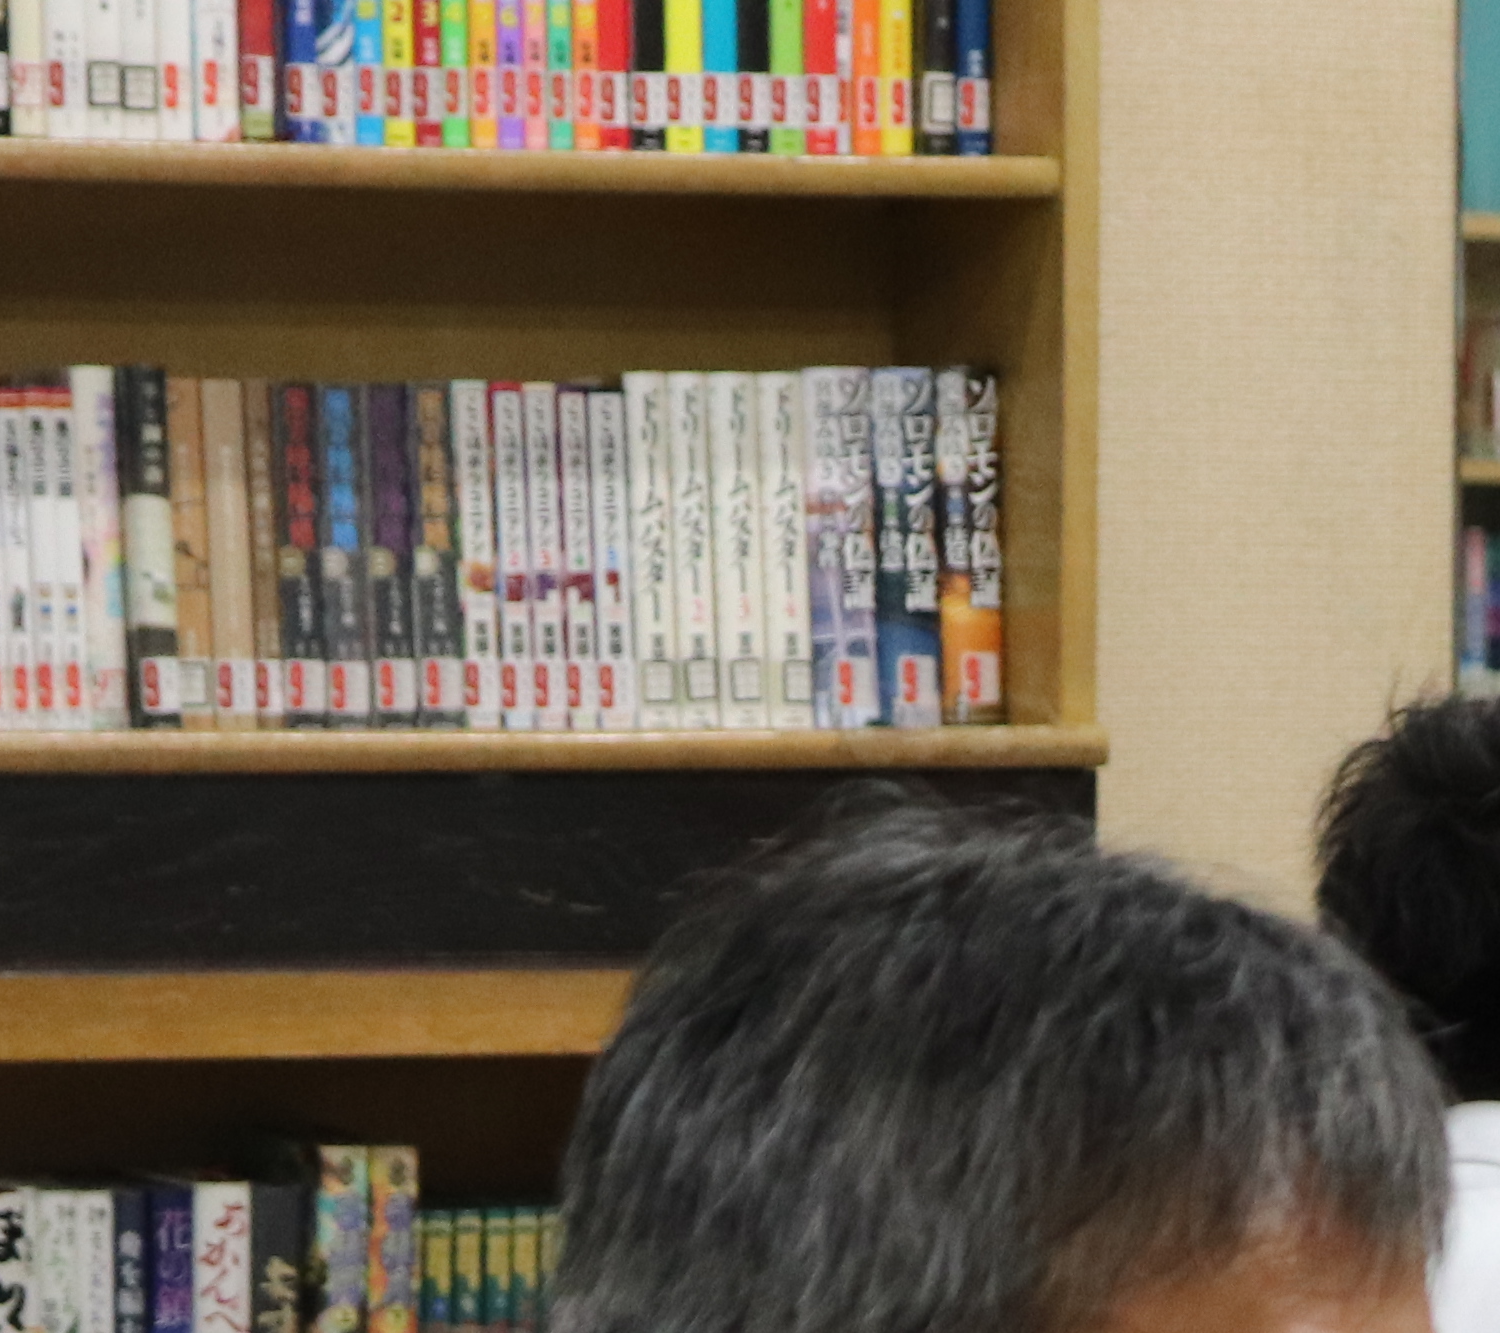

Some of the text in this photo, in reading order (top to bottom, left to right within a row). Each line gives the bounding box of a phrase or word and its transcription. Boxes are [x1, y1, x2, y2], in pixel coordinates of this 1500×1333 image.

[641, 394, 664, 622] ドリームバスター
[682, 394, 705, 595] ドリームバスター
[729, 393, 753, 595] ドリームバスター
[776, 394, 797, 593] ドリームバスター
[838, 373, 875, 611] ソロモンの偽証
[902, 373, 940, 613] ソロモンの偽証
[967, 373, 1003, 610] ソロモンの偽証
